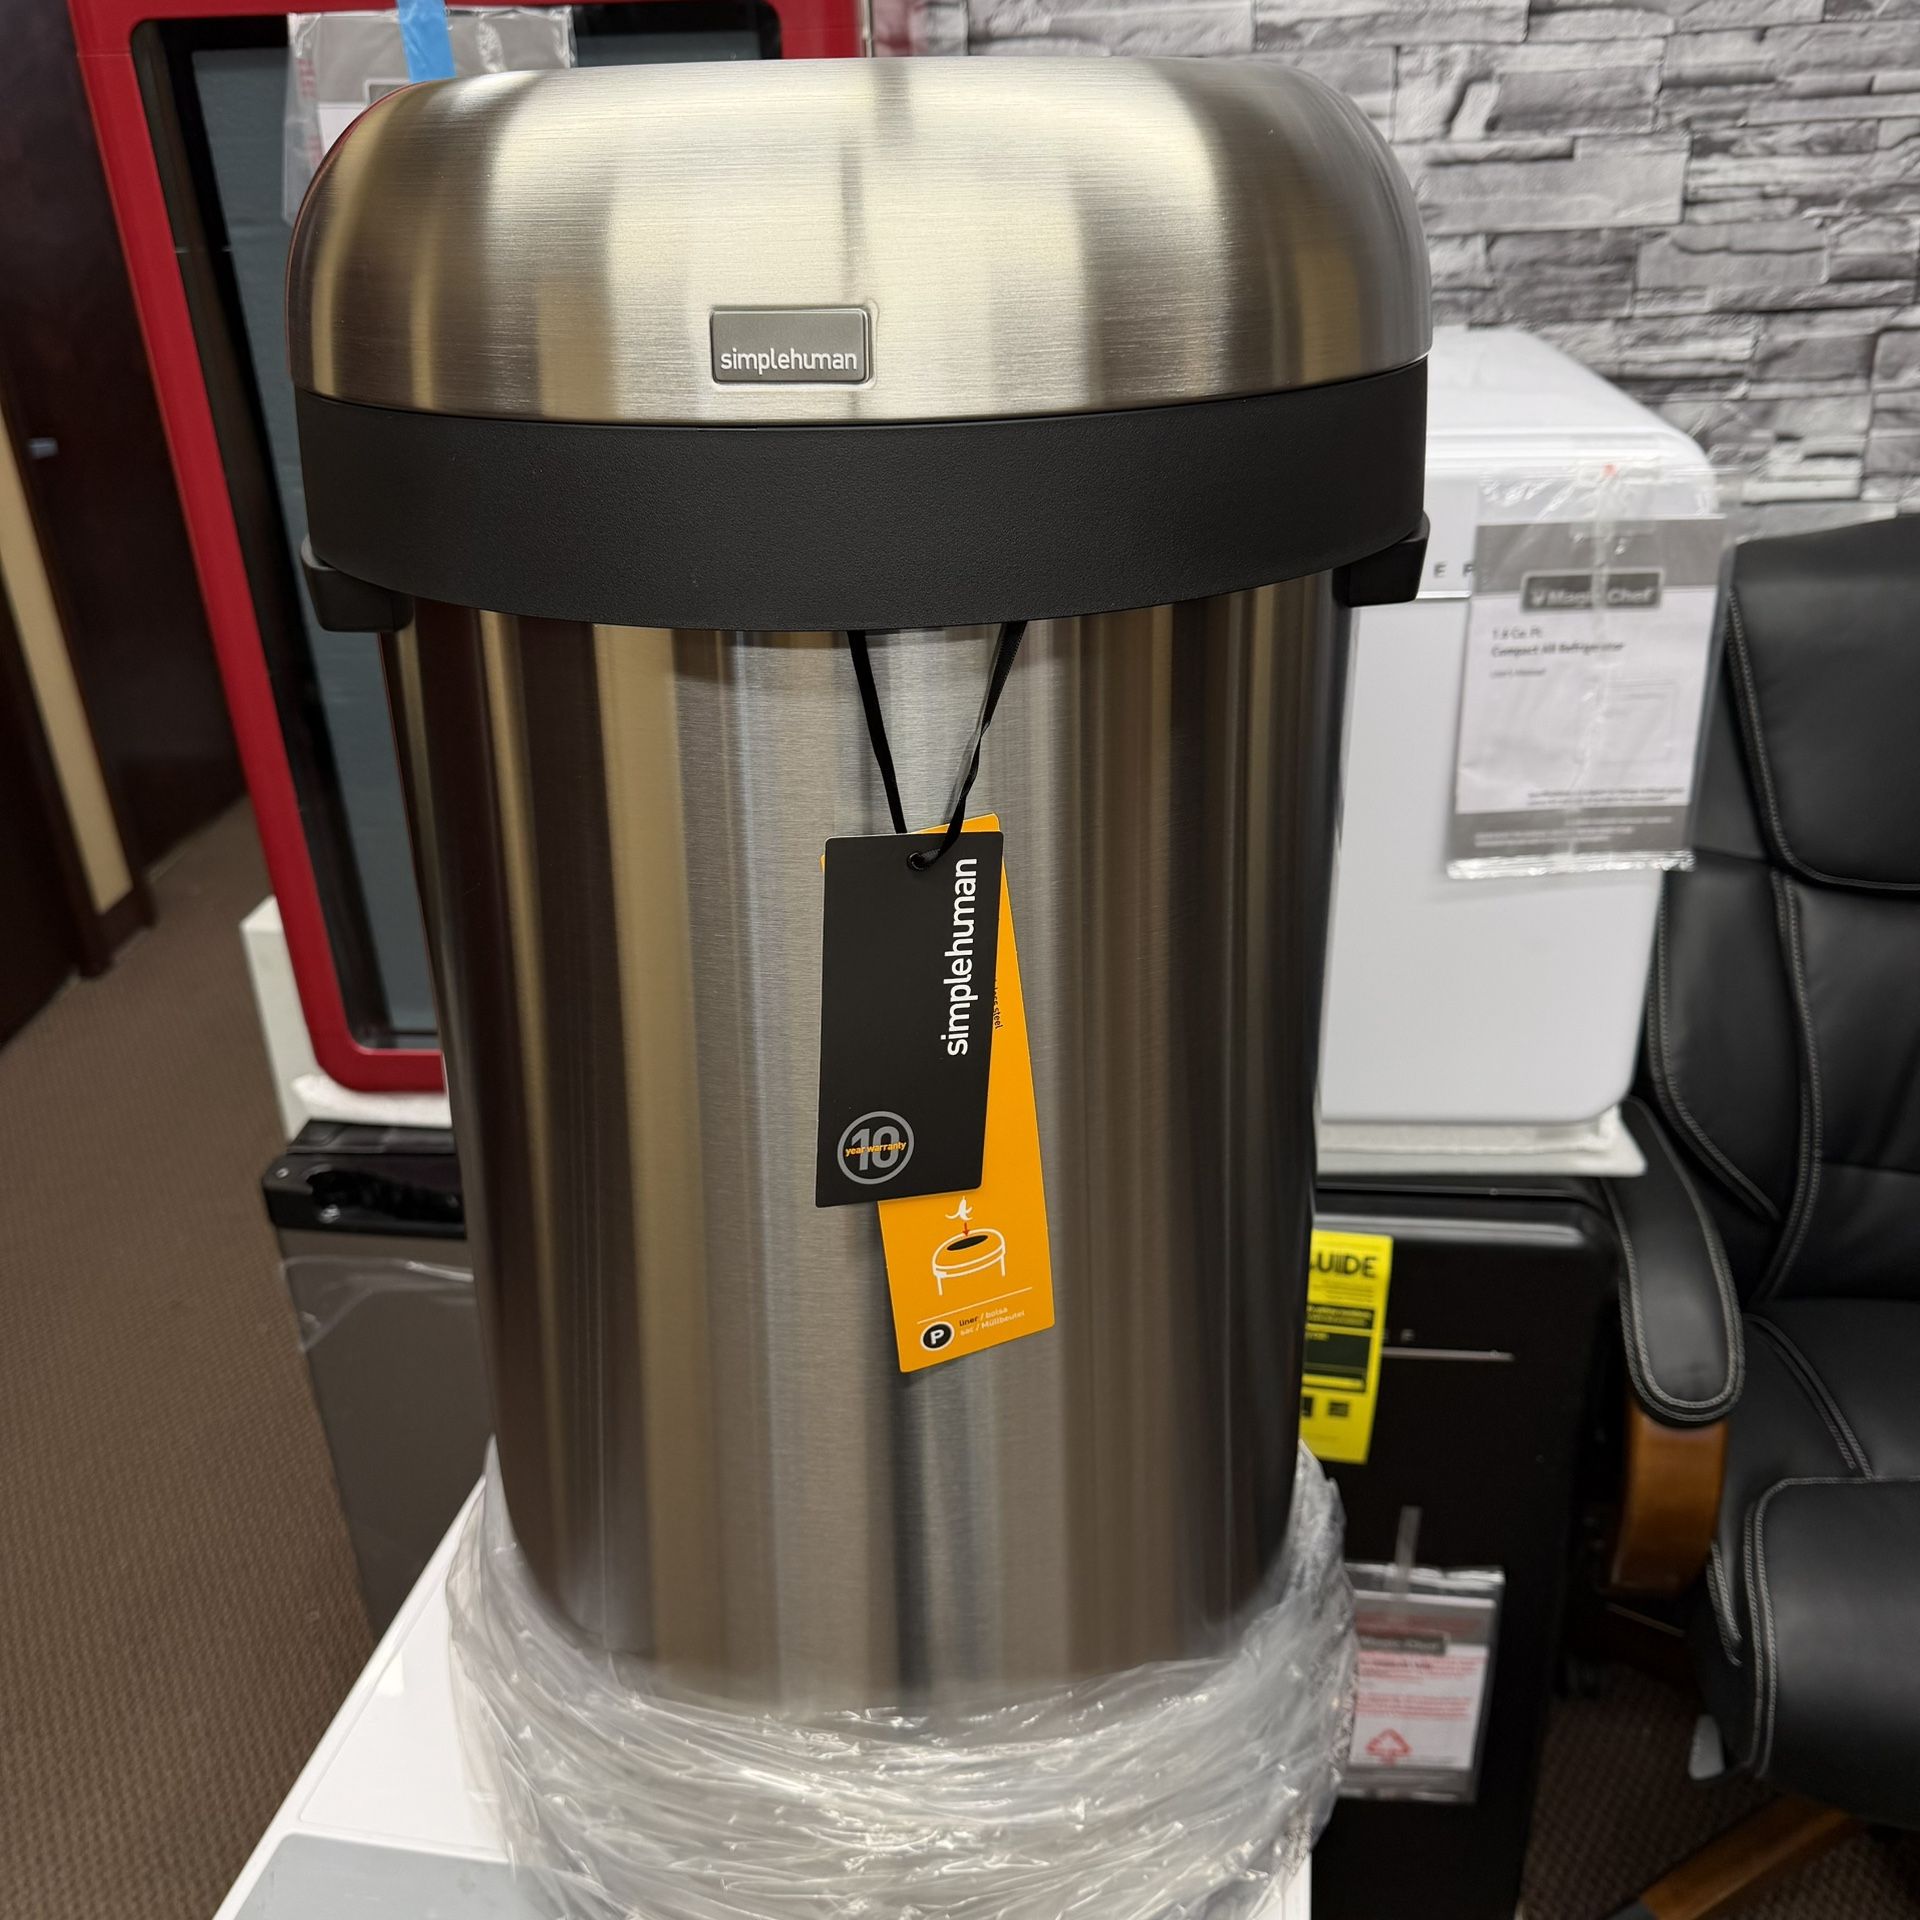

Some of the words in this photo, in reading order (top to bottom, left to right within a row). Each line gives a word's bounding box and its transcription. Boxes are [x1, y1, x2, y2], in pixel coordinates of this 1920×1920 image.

[720, 347, 857, 376] simplehuman
[940, 858, 979, 1056] simplehuman
[845, 1146, 866, 1157] year
[866, 1141, 907, 1153] warranty
[851, 1125, 900, 1172] 10
[1310, 1252, 1378, 1279] UIDE
[958, 1315, 979, 1327] liner
[985, 1307, 1009, 1319] bolsa
[929, 1328, 946, 1346] P
